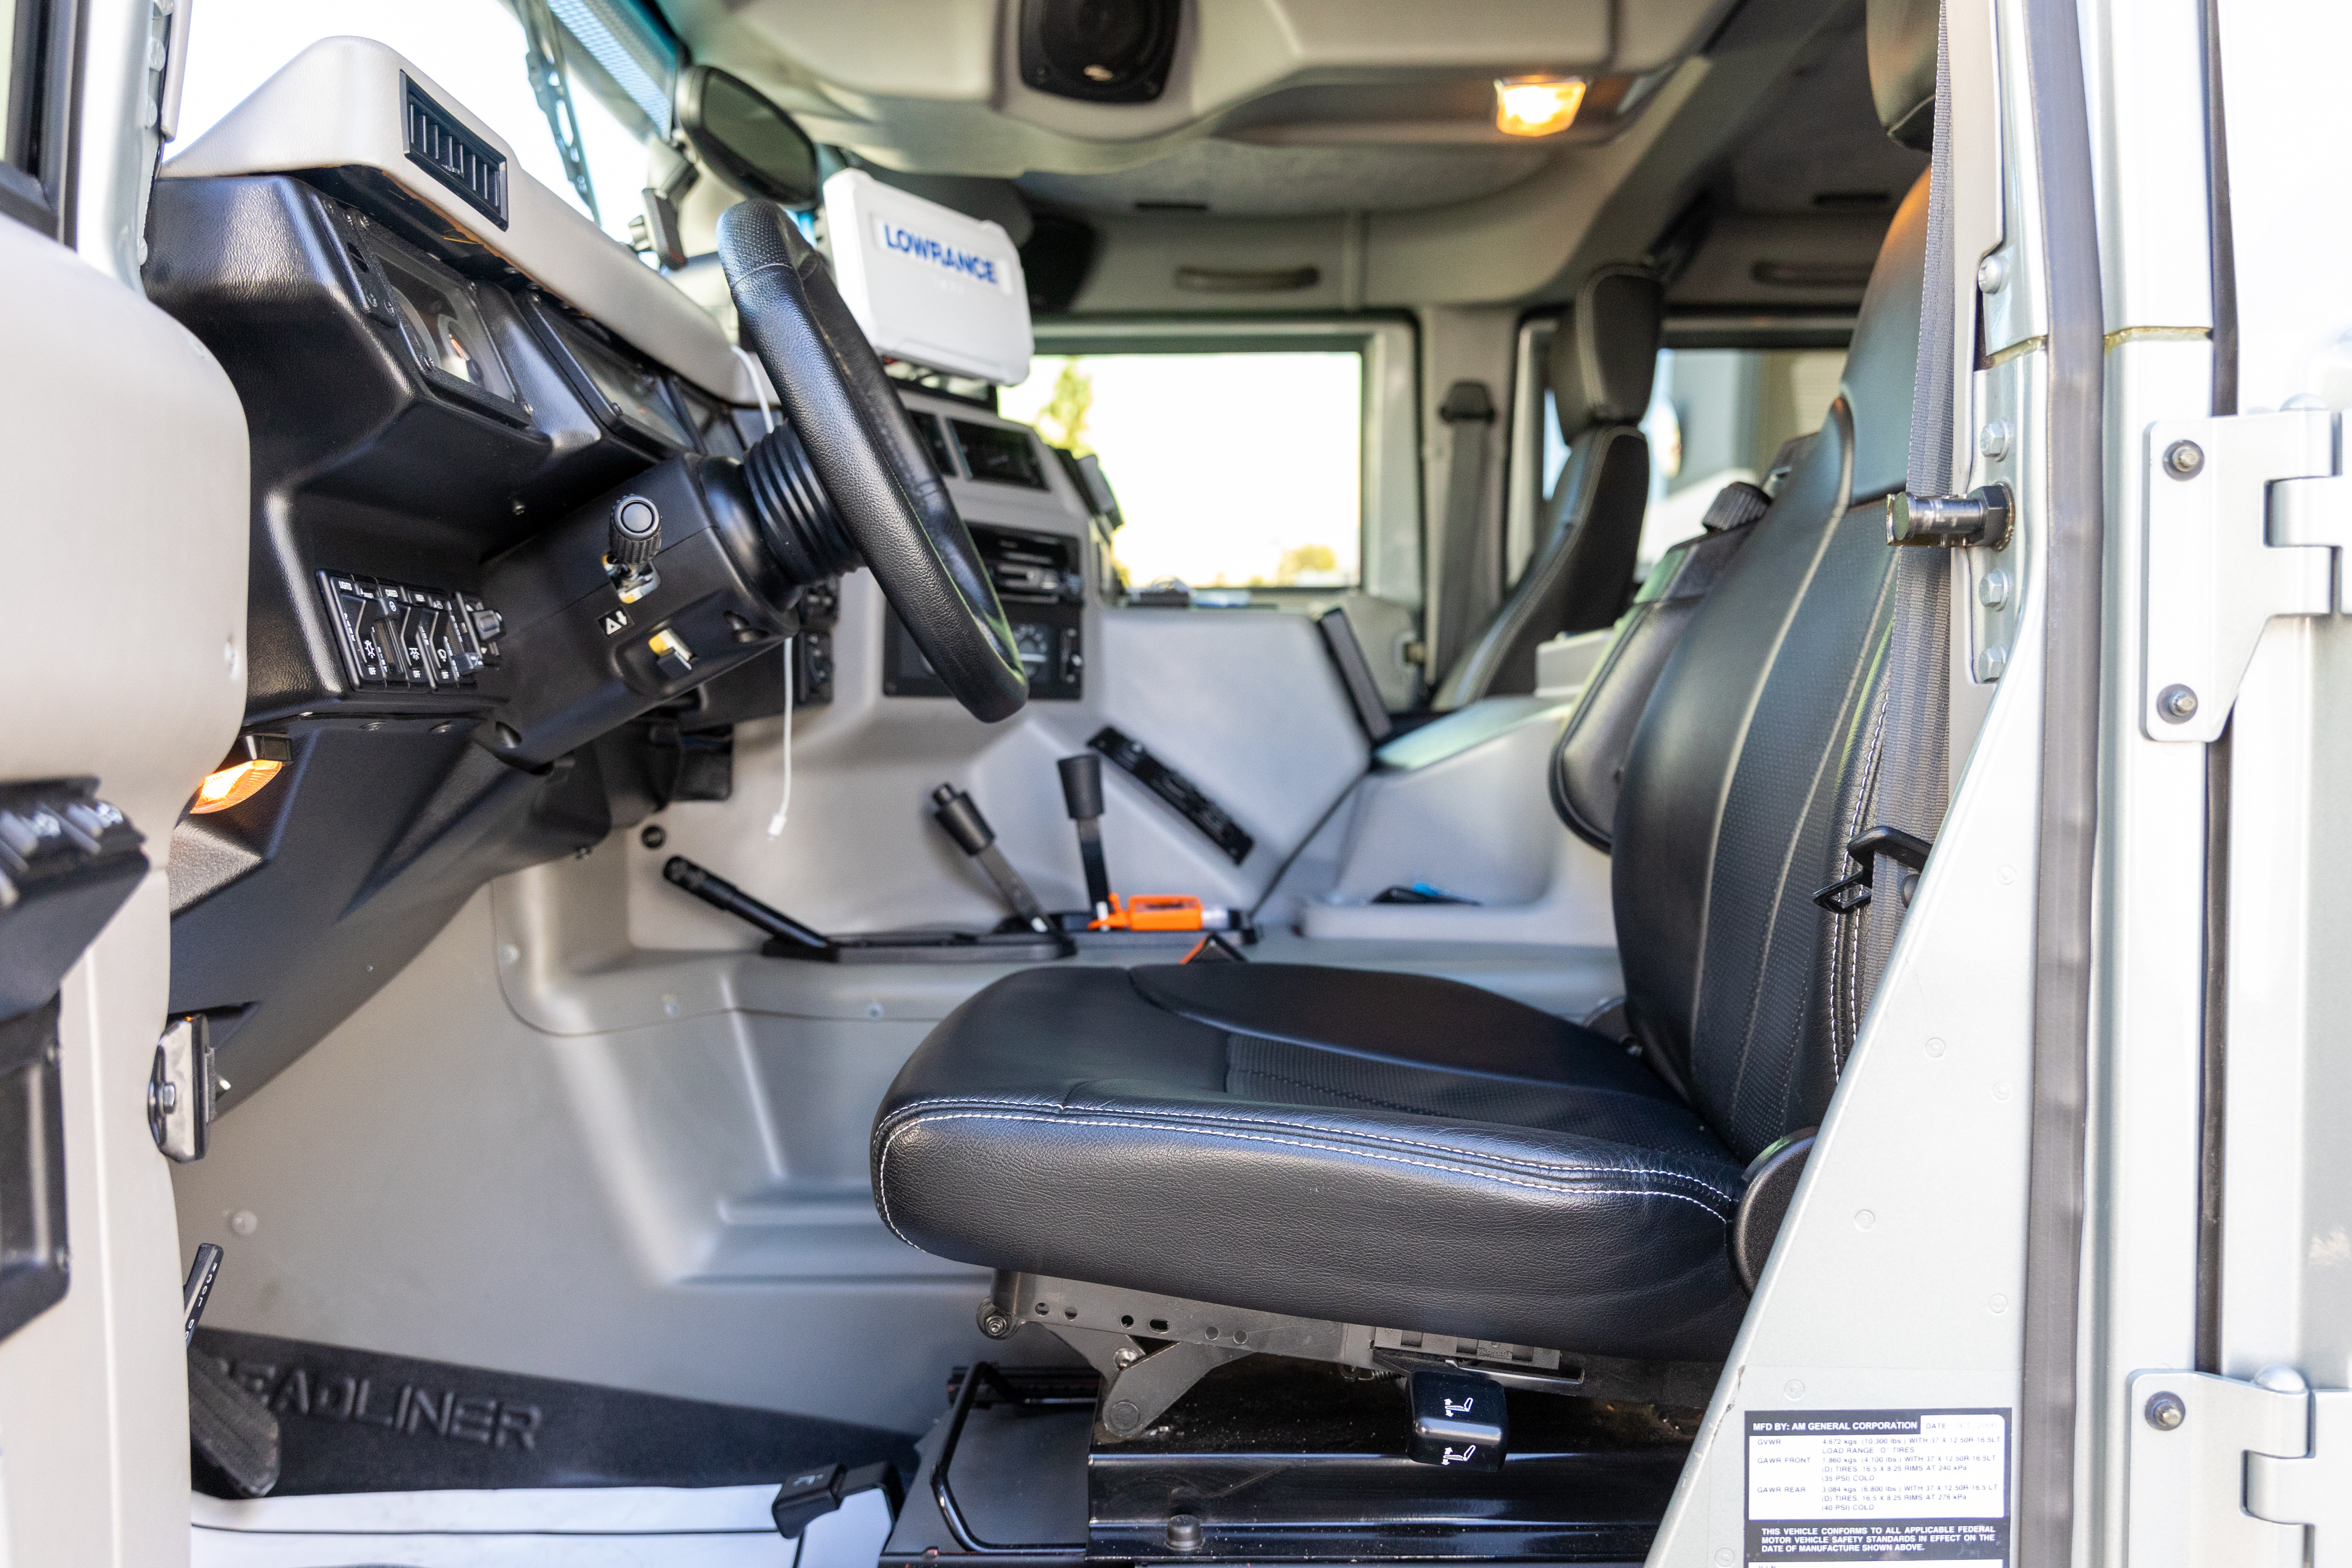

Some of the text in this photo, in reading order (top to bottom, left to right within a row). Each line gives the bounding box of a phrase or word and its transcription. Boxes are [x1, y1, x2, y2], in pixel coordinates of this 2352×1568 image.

[884, 224, 998, 285] LOWRANCE
[198, 1262, 217, 1307] LOCK
[1792, 1422, 1806, 1430] AM
[1807, 1422, 1851, 1430] GENERAL
[1852, 1421, 1917, 1430] CORPORATION
[1866, 1535, 1916, 1543] STANDARDS
